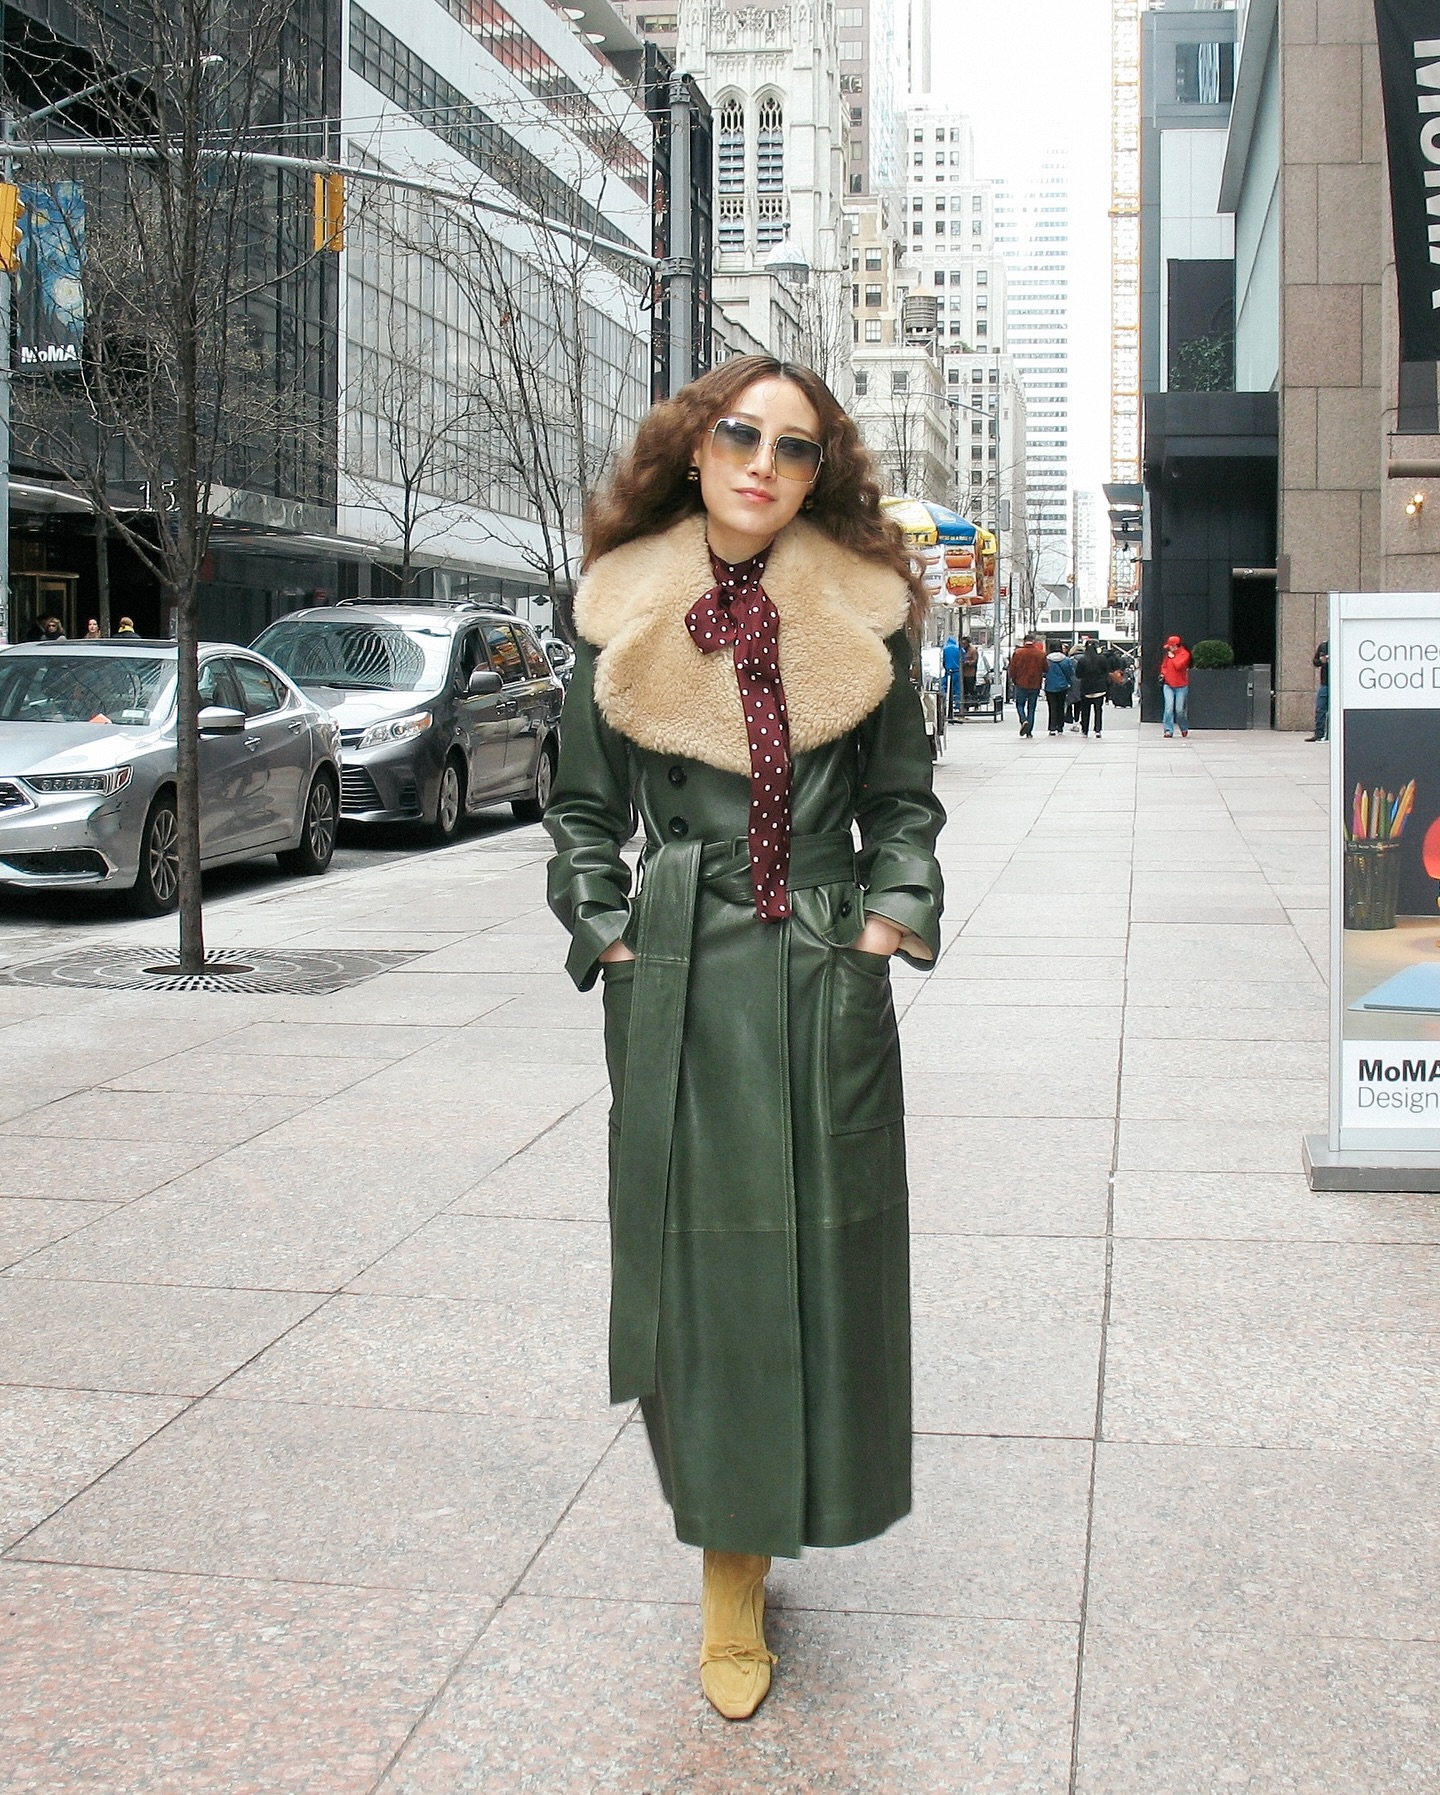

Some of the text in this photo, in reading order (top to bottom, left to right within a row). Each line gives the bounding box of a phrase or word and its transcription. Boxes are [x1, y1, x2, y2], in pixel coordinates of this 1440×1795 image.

[21, 344, 77, 363] MoMA
[1358, 639, 1440, 662] Conne
[1358, 667, 1424, 689] Good
[1358, 1059, 1440, 1082] MoMA
[1358, 1086, 1439, 1114] Design
